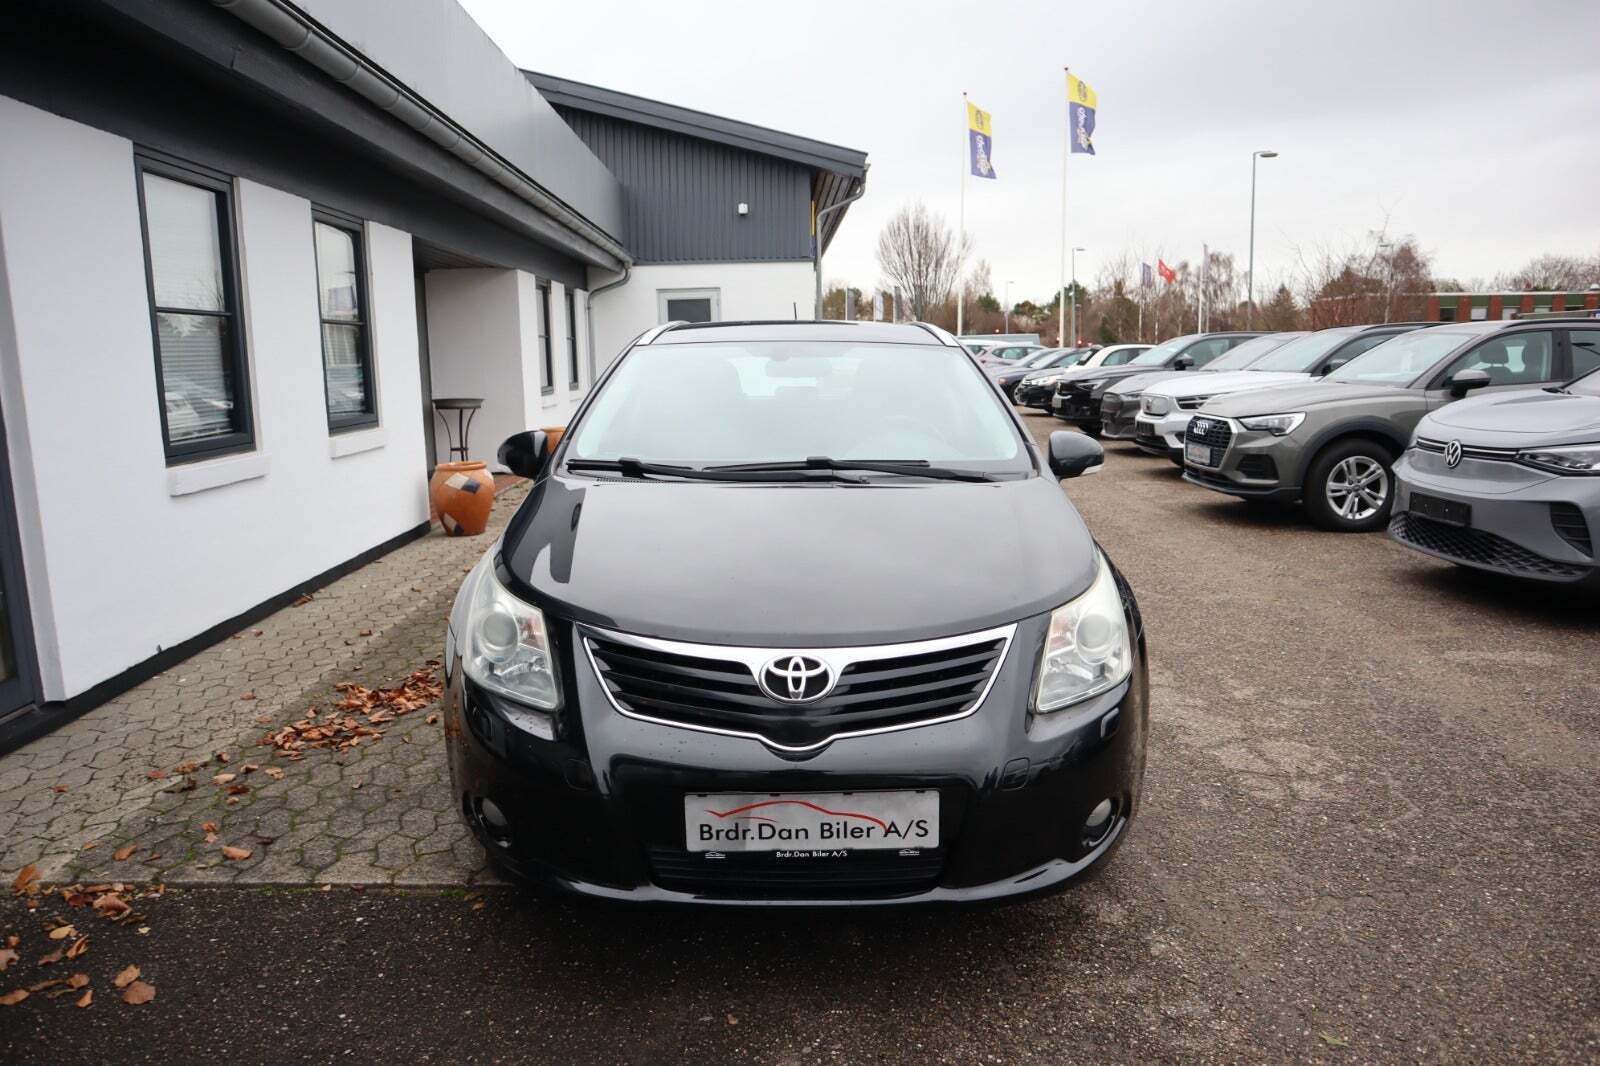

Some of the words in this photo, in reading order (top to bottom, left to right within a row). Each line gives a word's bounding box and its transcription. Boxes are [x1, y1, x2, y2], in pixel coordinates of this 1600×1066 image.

[699, 821, 809, 841] Brdr.Dan
[820, 820, 875, 839] Biler
[883, 819, 929, 840] A/S
